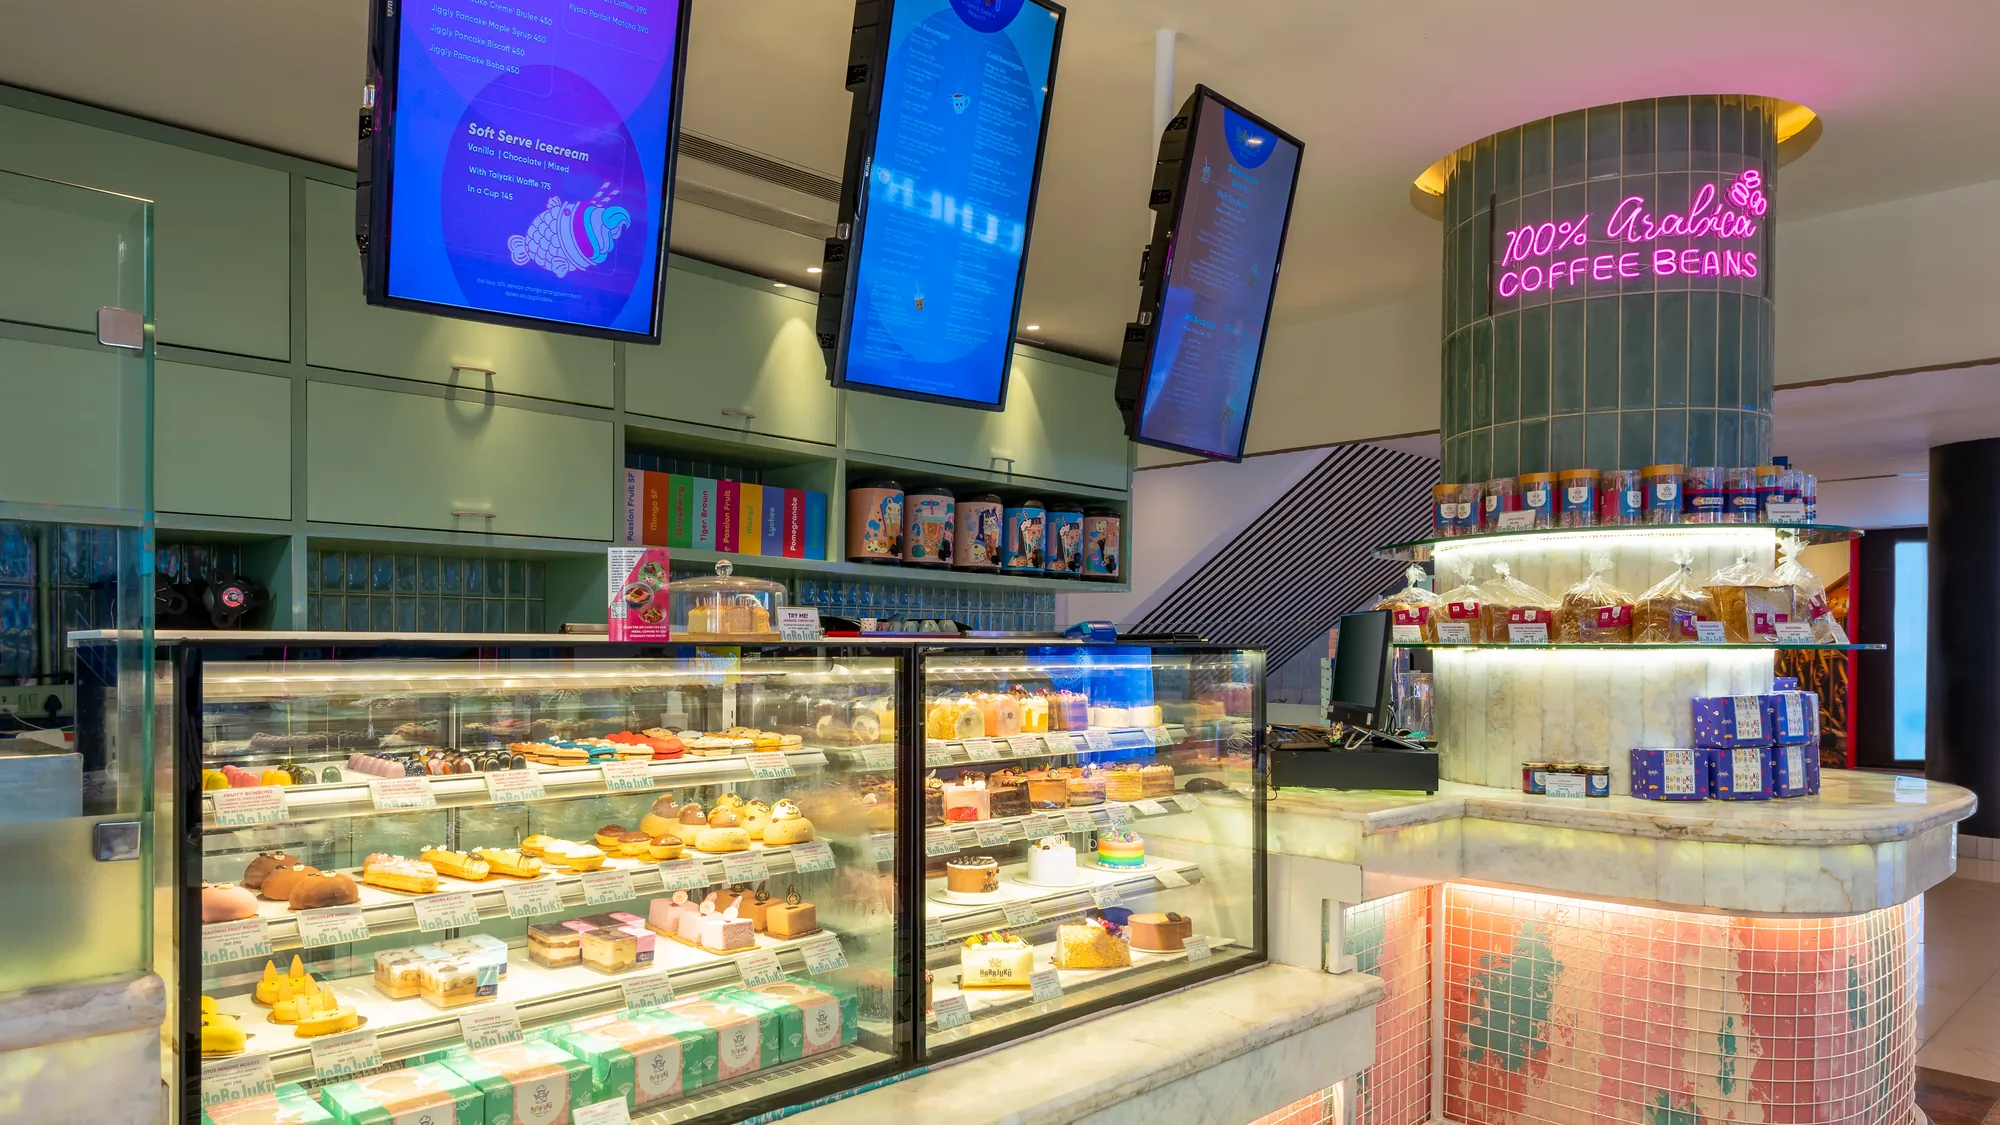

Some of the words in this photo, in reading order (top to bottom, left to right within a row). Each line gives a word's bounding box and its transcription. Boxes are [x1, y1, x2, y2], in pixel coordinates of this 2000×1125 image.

[431, 4, 453, 18] Jiggly
[456, 10, 487, 26] Pancake
[488, 20, 510, 33] Maple
[512, 28, 532, 41] Syrup
[533, 34, 547, 44] 450
[539, 17, 553, 26] 450
[569, 3, 588, 15] Kyoto
[612, 17, 636, 30] Matcha
[637, 25, 649, 34] 390
[635, 5, 647, 15] 390
[430, 24, 453, 37] Jiggly
[454, 30, 486, 46] Pancake
[487, 40, 511, 53] Biscoff
[512, 48, 525, 56] 450
[429, 44, 452, 57] Jiggly
[453, 50, 485, 65] Pancake
[486, 59, 505, 71] Boba
[506, 66, 520, 75] 450
[468, 122, 495, 140] Soft
[497, 129, 533, 149] Serve
[535, 139, 590, 162] Icecream
[467, 142, 495, 156] Vanilla
[503, 151, 542, 167] Chocolate
[548, 161, 570, 173] Mixed
[467, 184, 475, 193] In
[483, 188, 499, 199] Cup
[501, 191, 514, 201] 145
[469, 166, 487, 177] With
[488, 169, 515, 183] Taiyaki
[516, 176, 539, 188] Waffle
[540, 181, 552, 191] 175
[1501, 213, 1591, 267] 100%
[1606, 184, 1758, 243] Arabica
[1499, 252, 1641, 297] COFFEE
[1653, 249, 1758, 279] BEANS
[628, 472, 635, 483] SF
[627, 485, 635, 507] Fruit
[651, 489, 658, 499] SF
[627, 509, 635, 542] Passion
[650, 501, 659, 531] Mango
[676, 486, 685, 537] Strawberry
[746, 505, 754, 534] Mango
[768, 507, 776, 537] Lychee
[790, 497, 799, 551] Pomegranate
[701, 519, 709, 542] Tiger
[723, 512, 731, 544] Passion
[306, 913, 334, 921] CHOCOLATE
[474, 1016, 495, 1024] BANOFFEE
[217, 1063, 239, 1072] MINIONS
